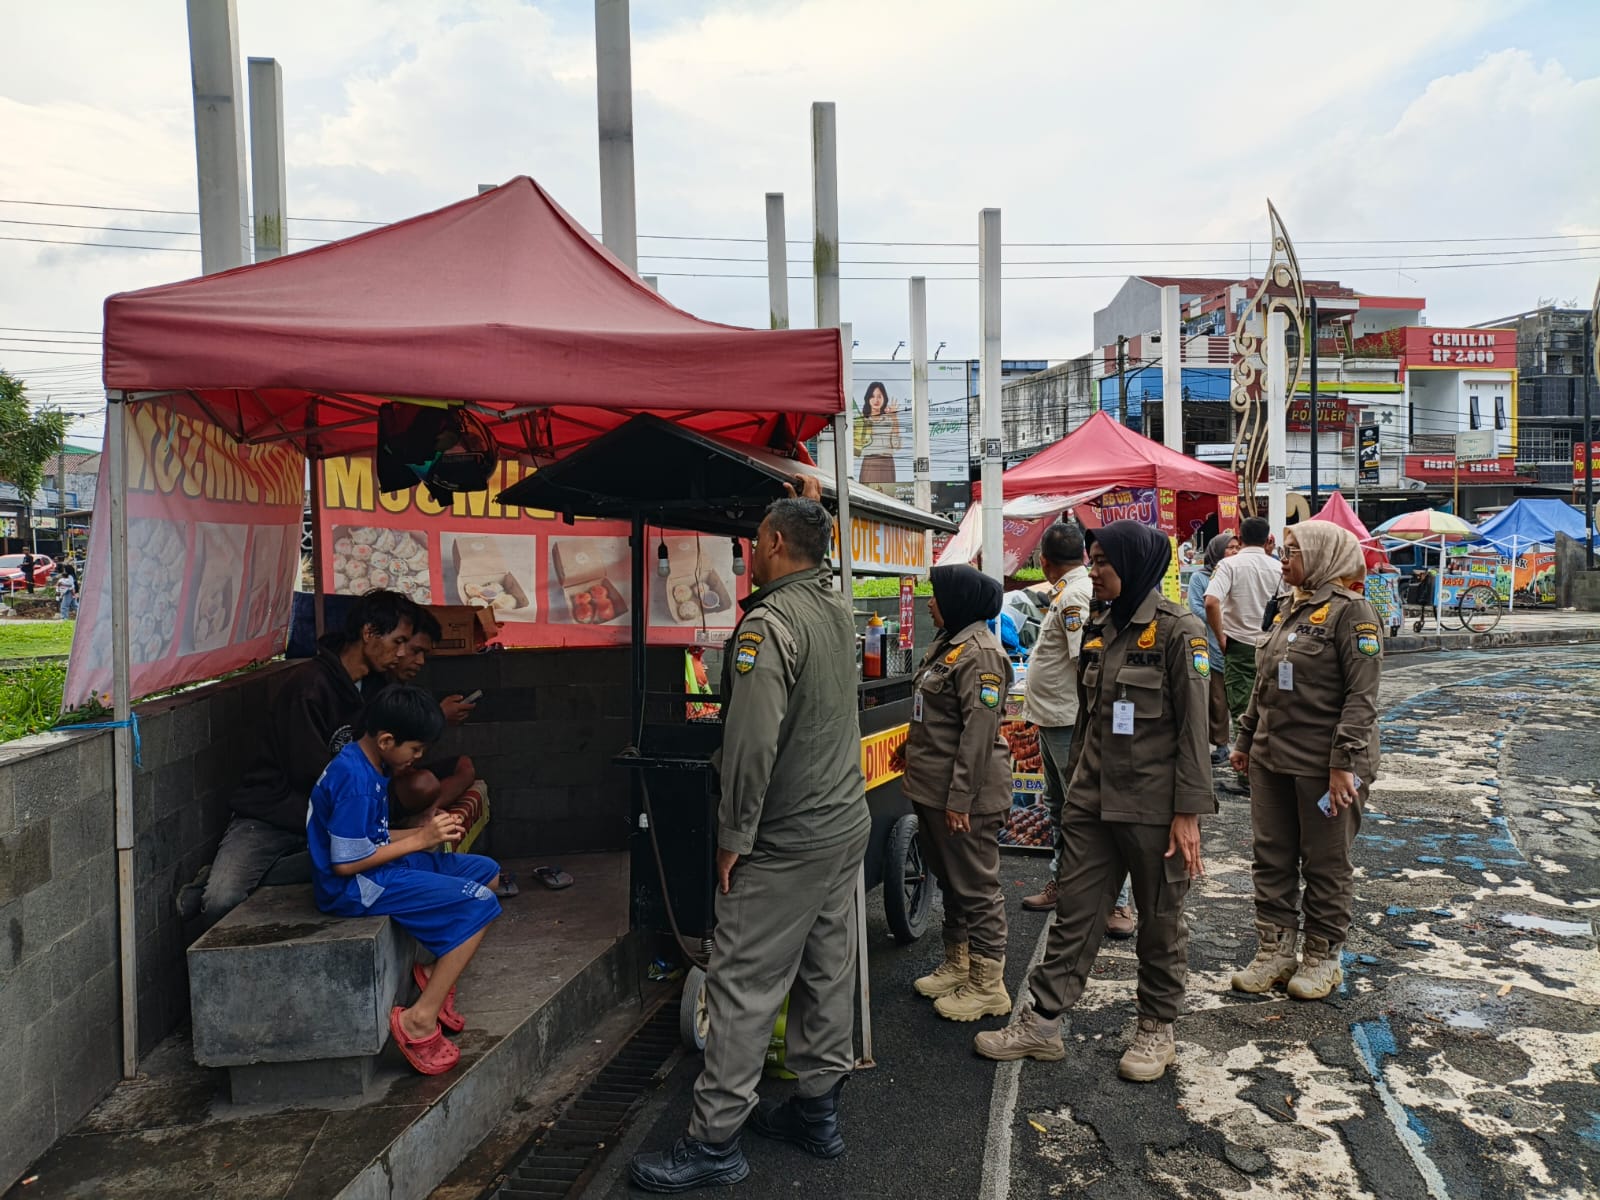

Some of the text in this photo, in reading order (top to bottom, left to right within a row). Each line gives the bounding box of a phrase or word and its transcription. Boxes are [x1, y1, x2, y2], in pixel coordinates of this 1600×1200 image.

[1432, 332, 1495, 347] CEMILAN
[1432, 349, 1495, 363] RP 2.000
[1291, 410, 1345, 421] POULER
[1102, 501, 1153, 526] UNGU
